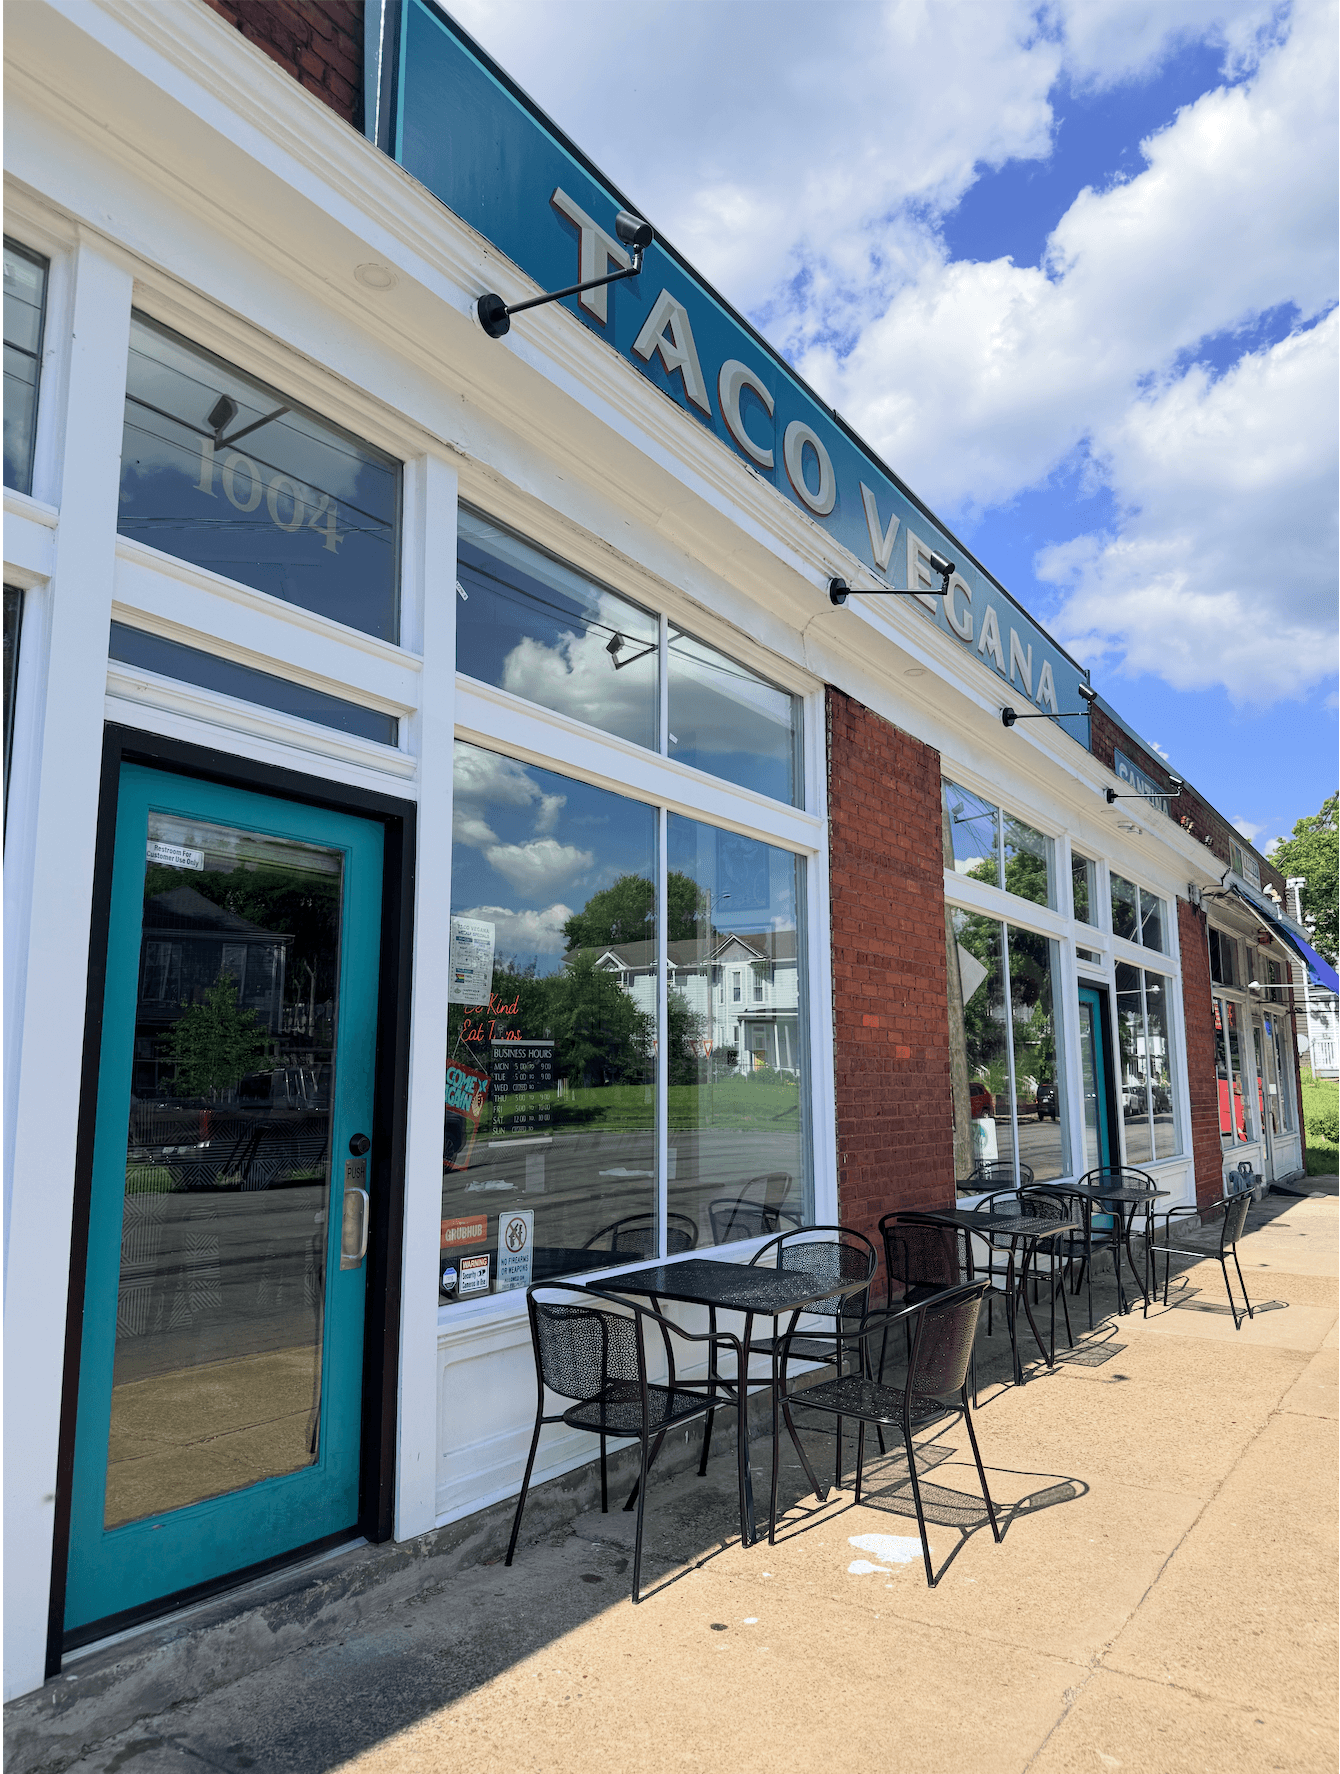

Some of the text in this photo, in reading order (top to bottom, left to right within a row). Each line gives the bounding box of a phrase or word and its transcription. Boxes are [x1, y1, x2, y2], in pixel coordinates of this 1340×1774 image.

[550, 186, 1060, 722] TACO VEGANA
[193, 436, 345, 554] 1004
[154, 844, 192, 858] Restroom For
[147, 850, 199, 868] Customer Use Only
[487, 992, 519, 1015] Kind
[460, 1019, 484, 1043] Eat
[493, 1048, 552, 1059] BUSINESS HOURS
[446, 1066, 478, 1094] COME
[494, 1073, 506, 1081] TUE
[493, 1105, 503, 1113] FRI
[493, 1116, 504, 1124] SAT
[493, 1127, 505, 1135] SUN
[347, 1167, 365, 1179] PUSH
[445, 1224, 483, 1241] GRUBHUB
[462, 1258, 487, 1269] WARNING
[501, 1255, 529, 1266] NO FIREARMS
[462, 1270, 476, 1280] Security
[501, 1263, 528, 1275] OR WEAPONS
